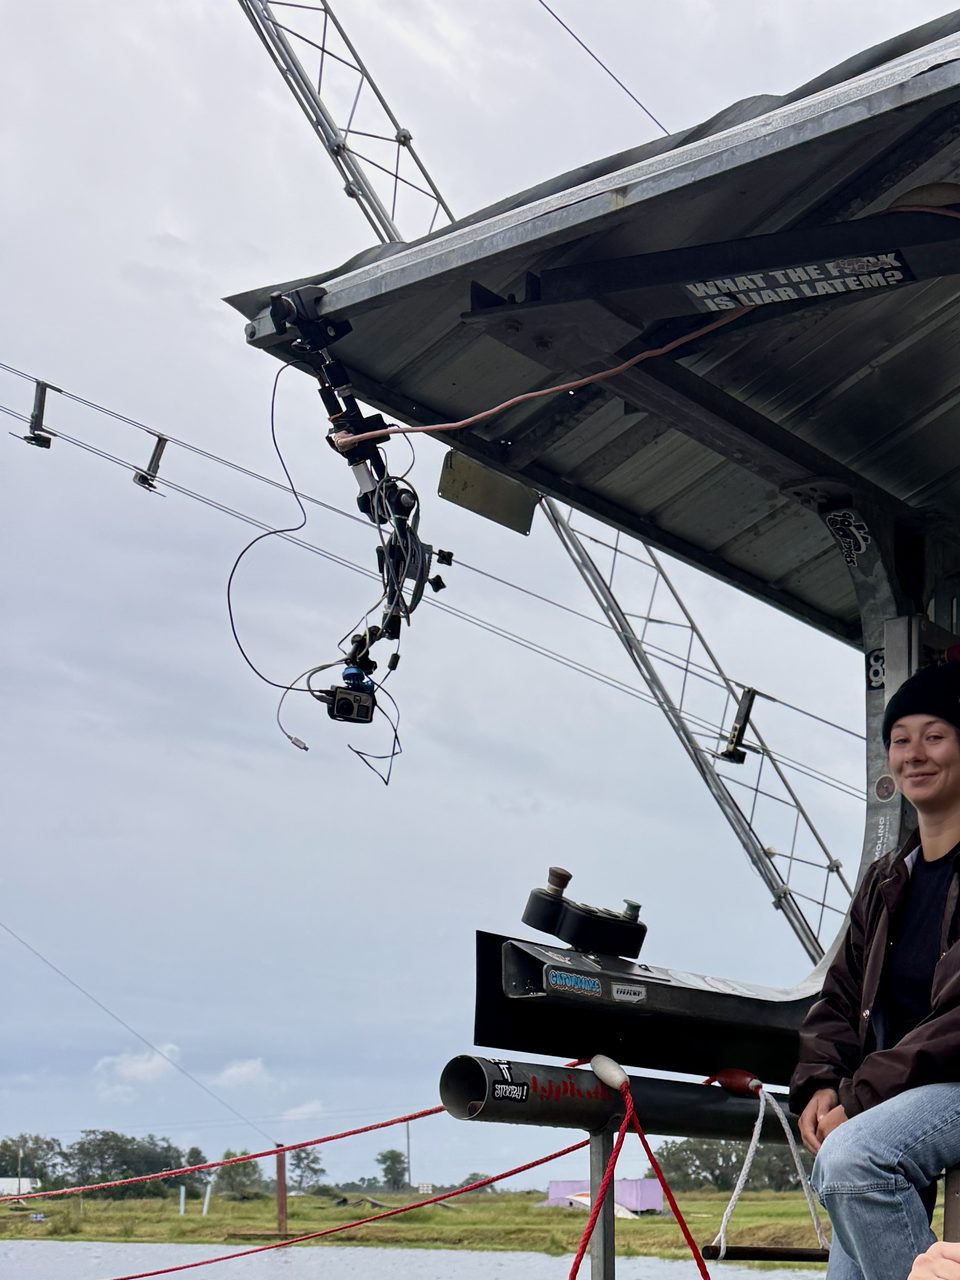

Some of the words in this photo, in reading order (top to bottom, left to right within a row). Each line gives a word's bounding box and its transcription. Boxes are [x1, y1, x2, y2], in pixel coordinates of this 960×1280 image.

[686, 273, 767, 297] WHAT
[769, 265, 826, 285] THE
[703, 296, 736, 312] IS
[737, 286, 799, 306] LIAR
[799, 270, 904, 297] LATEM?
